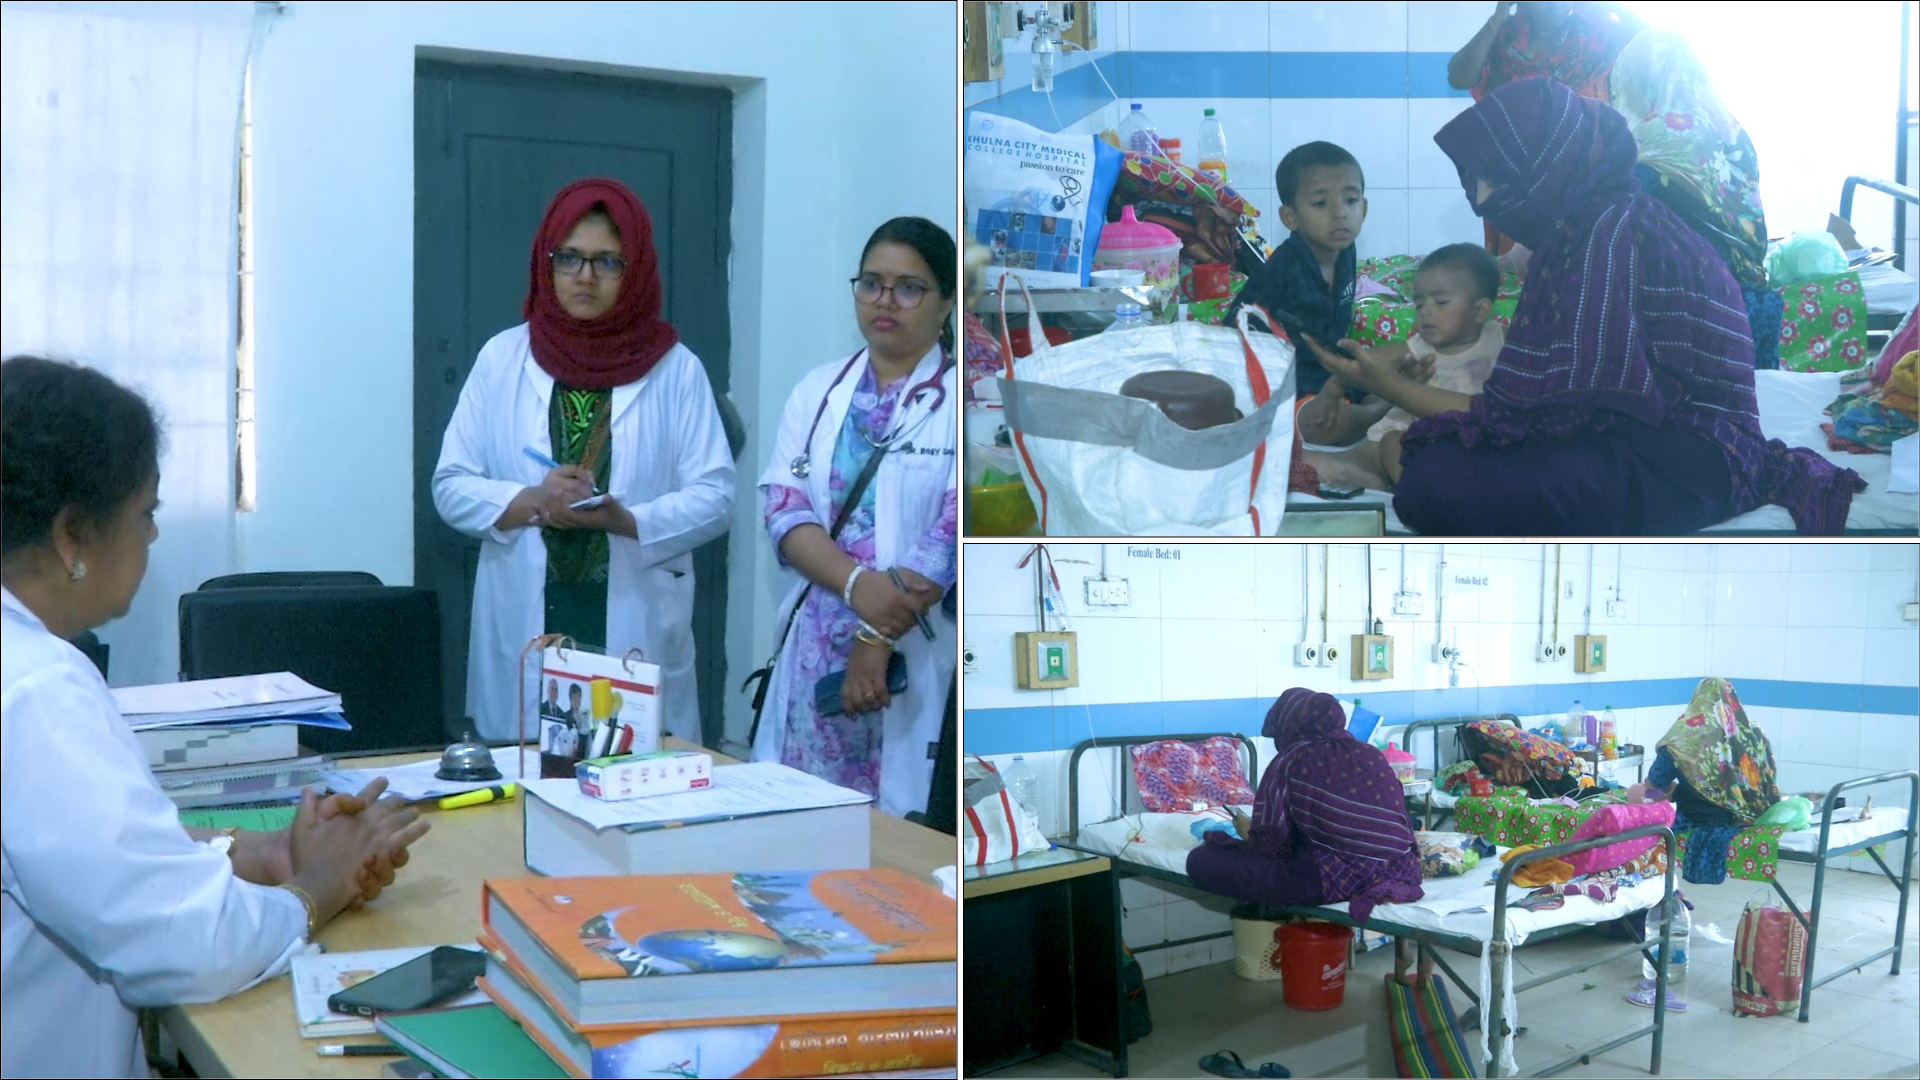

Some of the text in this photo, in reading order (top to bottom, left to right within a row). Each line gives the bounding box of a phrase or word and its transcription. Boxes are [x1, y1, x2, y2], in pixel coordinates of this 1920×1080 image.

[967, 143, 1086, 166] COLLEGE HOSPITAL
[968, 135, 1087, 160] KHULNA CITY MEDICAL
[1020, 160, 1086, 176] passion to care
[1127, 546, 1181, 560] Female Bed: 01
[1455, 575, 1471, 585] Female
[1790, 917, 1803, 977] ASHUNDHARA
